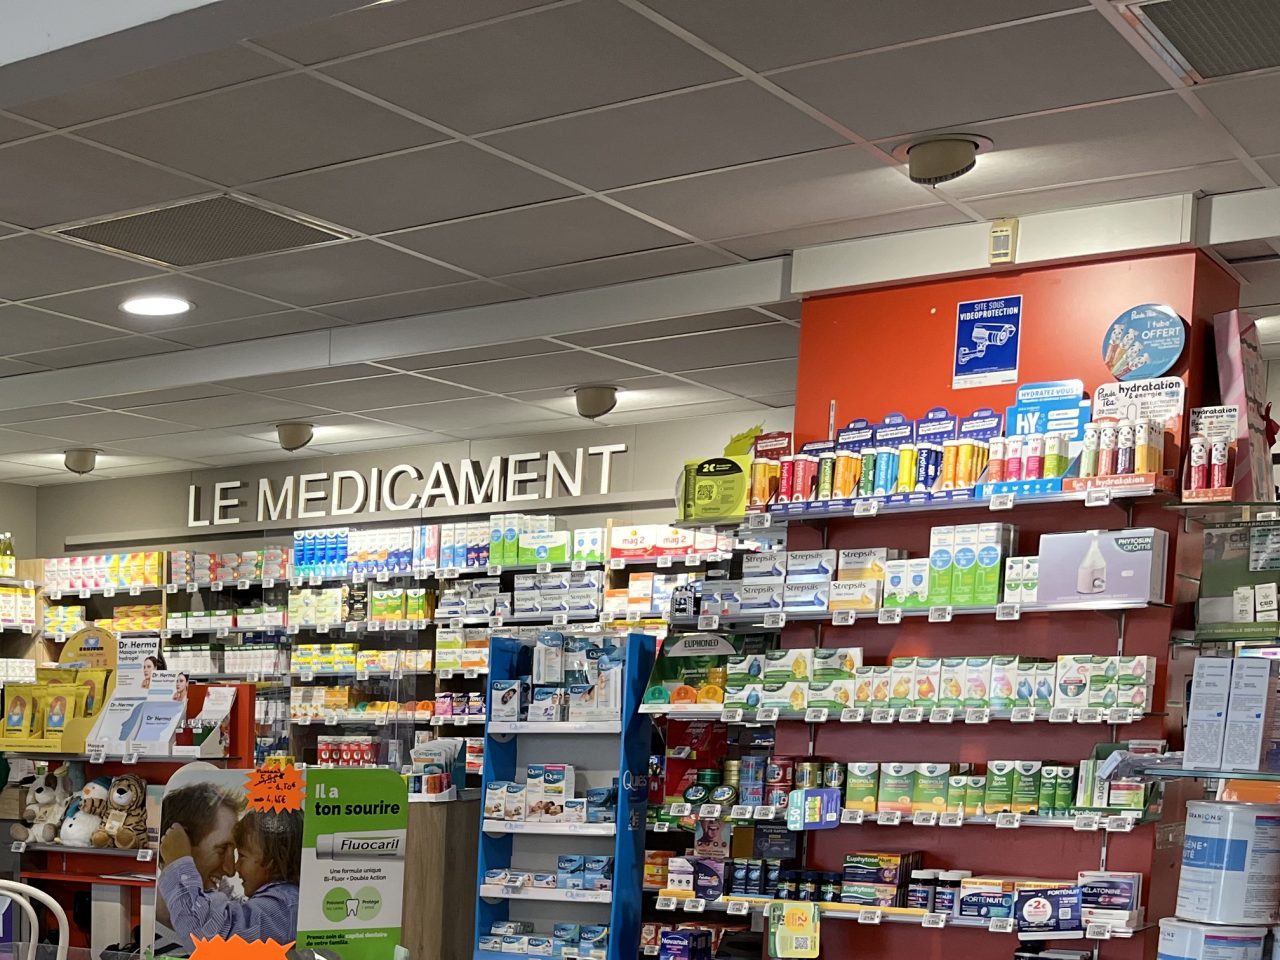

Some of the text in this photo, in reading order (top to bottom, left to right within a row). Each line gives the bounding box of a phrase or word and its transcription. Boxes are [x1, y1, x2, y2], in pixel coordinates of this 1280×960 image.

[975, 301, 1004, 311] SITE SOUS
[960, 307, 1018, 320] VIDEOPROTECTION
[1142, 327, 1181, 339] OFFERT
[1119, 380, 1181, 394] hydratation
[1192, 408, 1237, 416] hydratation
[1016, 413, 1040, 434] HY
[188, 444, 627, 527] LE MEDICAMENT
[663, 535, 679, 544] mag
[1118, 537, 1152, 545] PHYTOSUN
[1230, 533, 1250, 543] CB
[745, 554, 776, 563] Strepsils
[790, 552, 822, 561] Strepsils
[842, 550, 876, 559] Strepsils
[743, 586, 774, 594] Strepsils
[786, 584, 819, 592] Strepsils
[833, 582, 866, 590] Strepsils
[329, 787, 338, 798] a
[315, 801, 400, 816] ton sourire
[341, 839, 399, 850] Fluocaril
[846, 855, 879, 864] Euphytose
